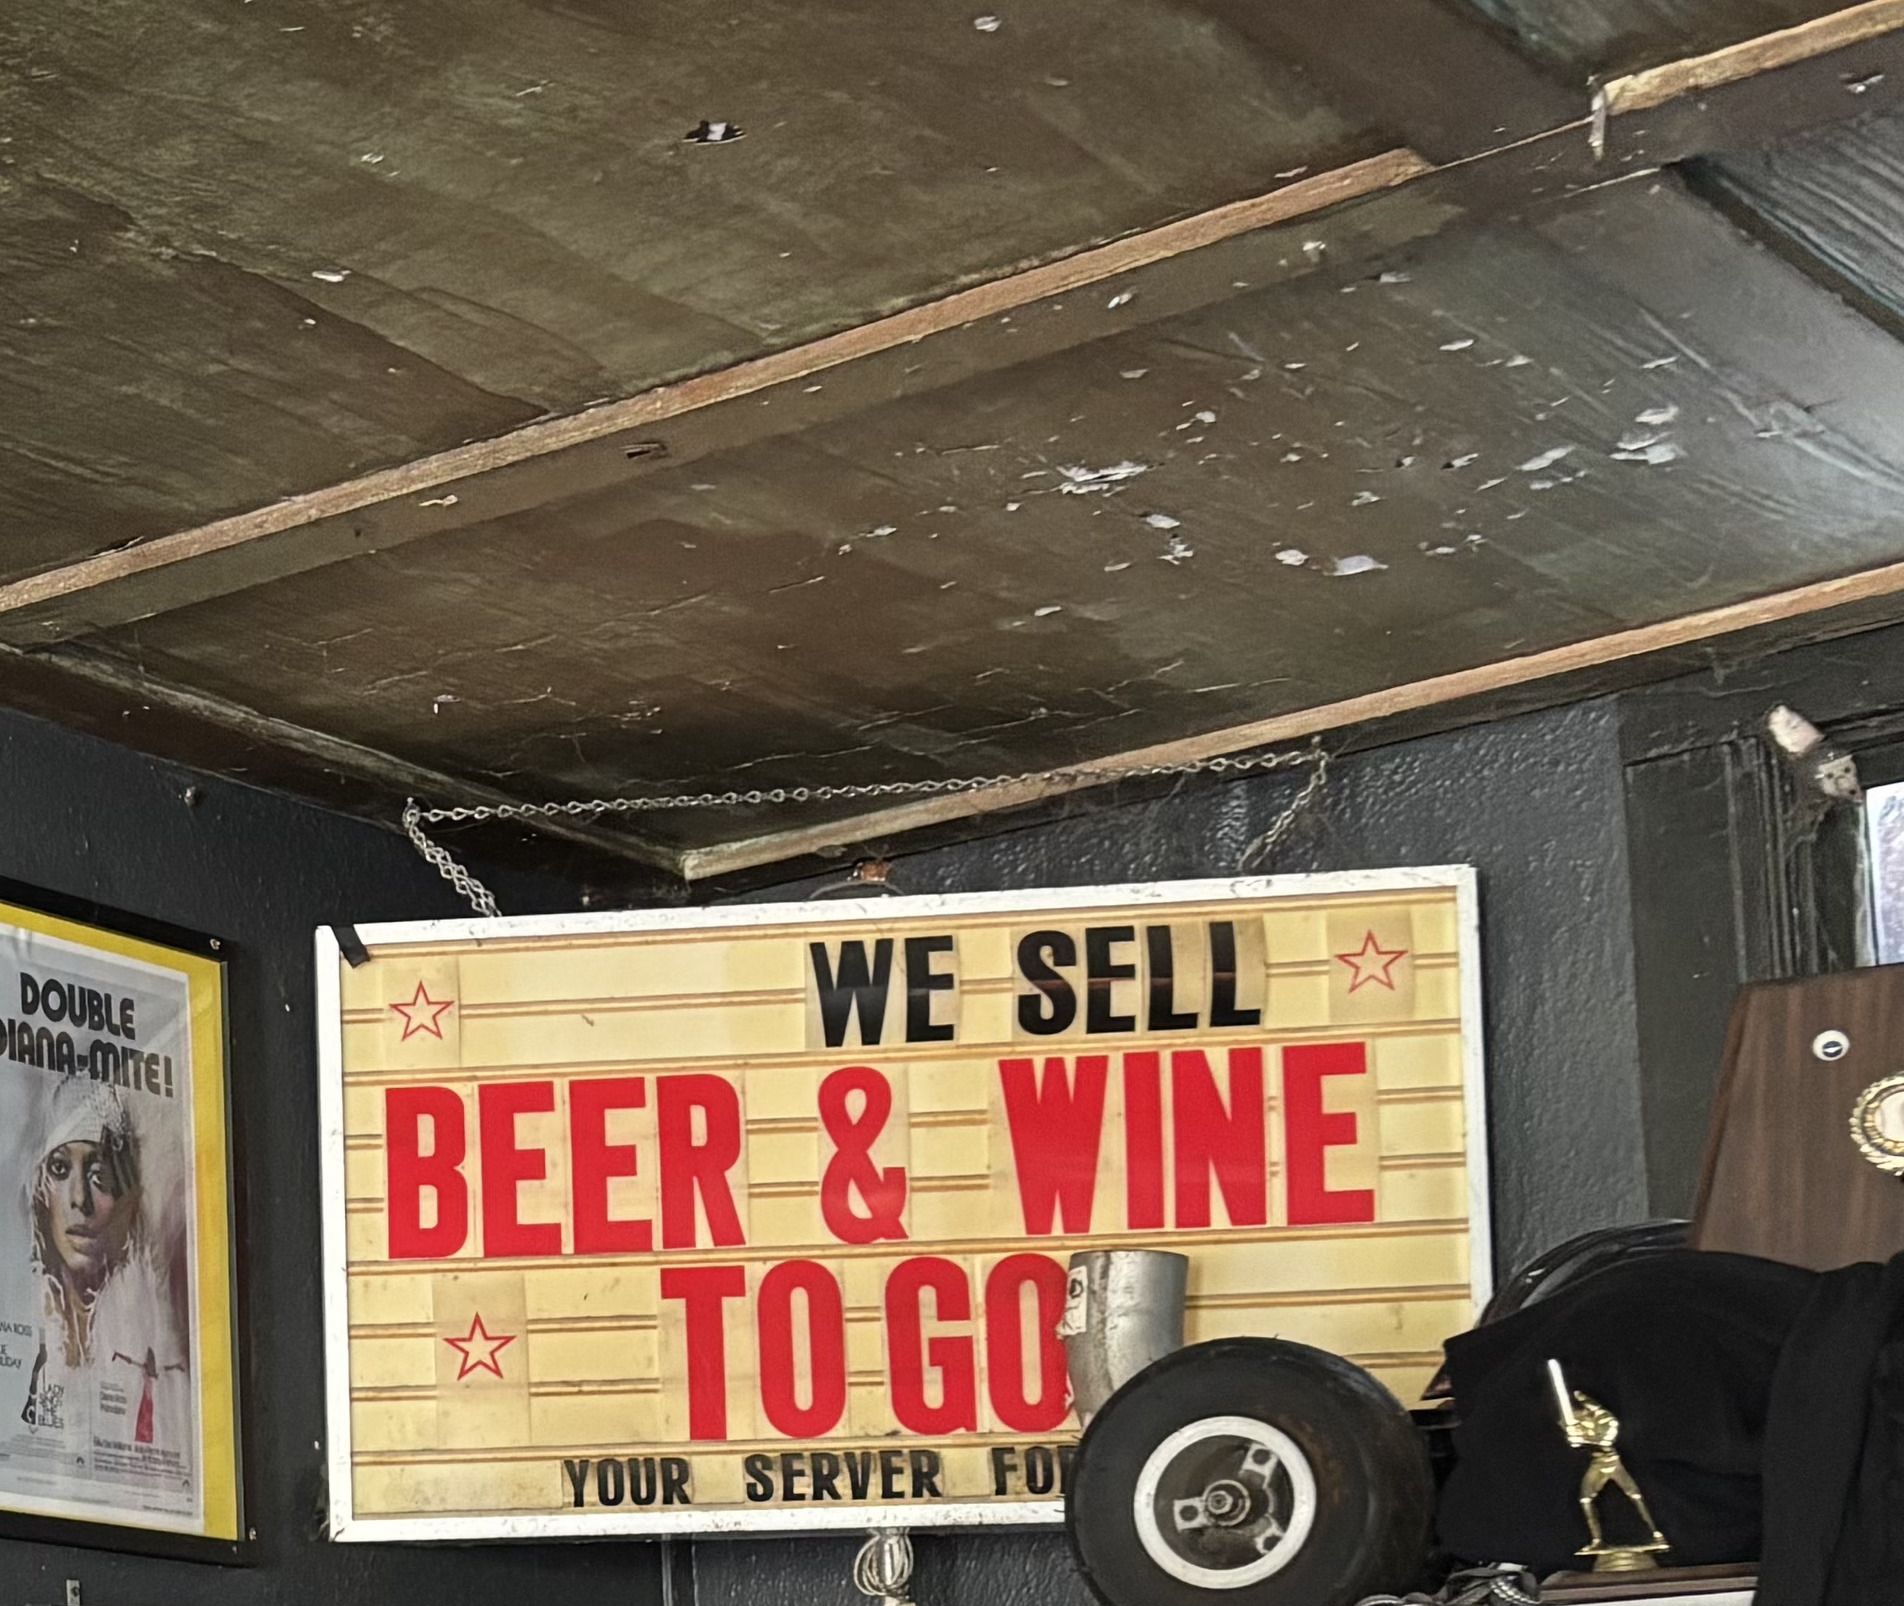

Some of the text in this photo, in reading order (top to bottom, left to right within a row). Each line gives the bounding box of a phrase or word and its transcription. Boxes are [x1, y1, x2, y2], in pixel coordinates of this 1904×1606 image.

[20, 972, 135, 1040] DOUBLE
[810, 921, 1262, 1048] WE SELL
[386, 1042, 1375, 1259] BEER & WINE
[660, 1252, 1071, 1441] TO GO
[563, 1458, 690, 1506] YOUR
[744, 1450, 941, 1501] SERVER
